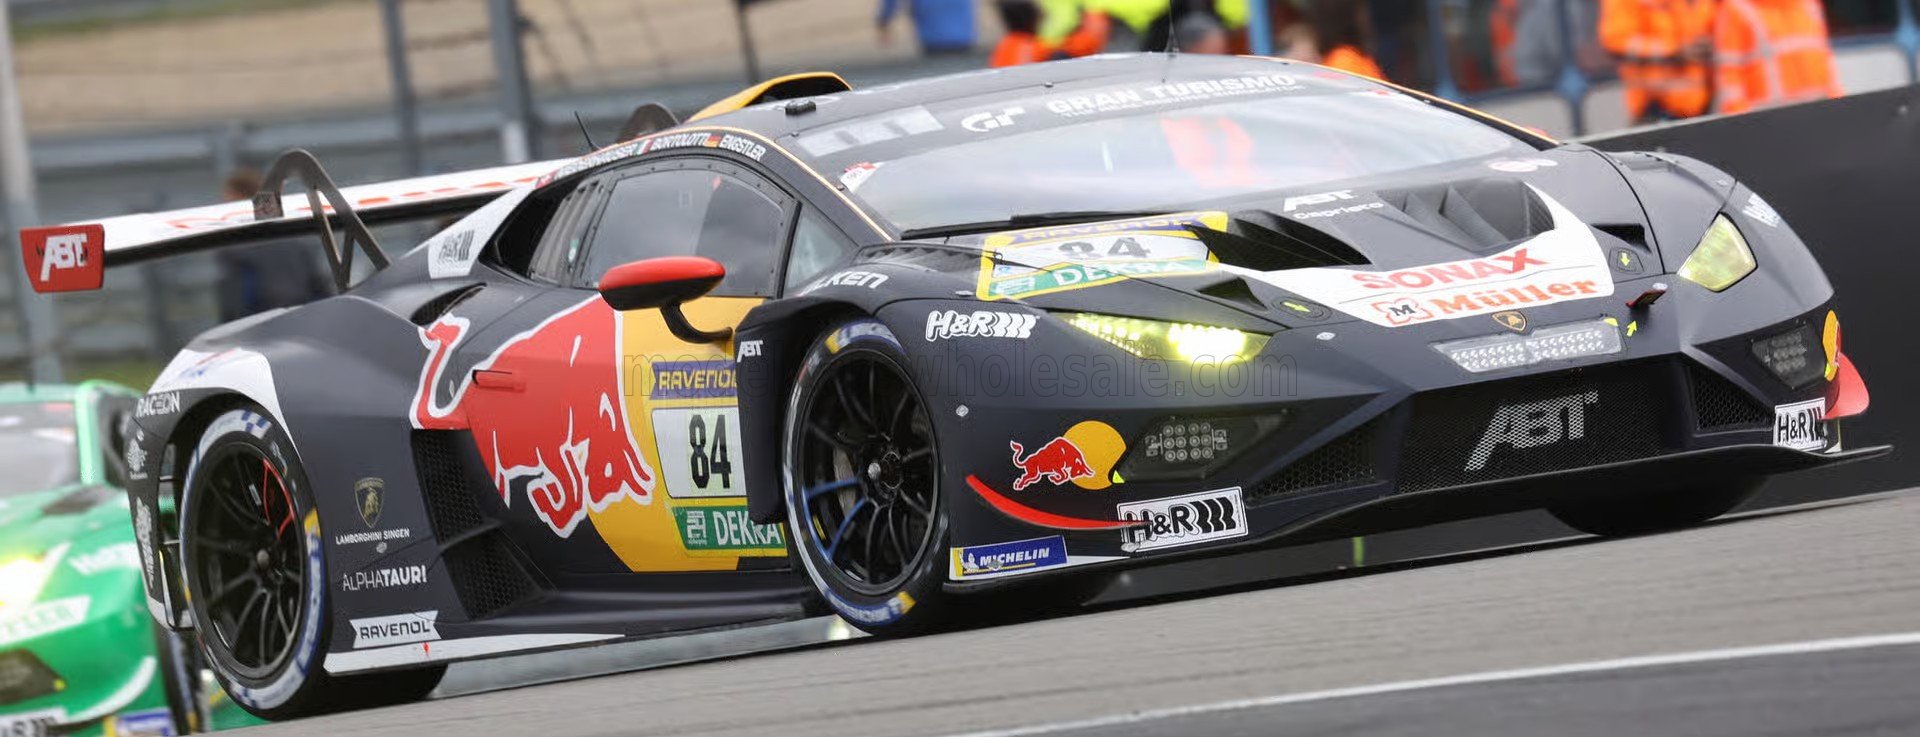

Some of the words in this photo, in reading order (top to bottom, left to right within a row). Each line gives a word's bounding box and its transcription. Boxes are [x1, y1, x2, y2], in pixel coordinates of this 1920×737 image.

[1048, 90, 1140, 113] GRAN
[1144, 75, 1296, 101] TURISMO
[720, 134, 767, 161] ENGSTLER
[40, 232, 88, 282] ABT
[1353, 248, 1549, 290] SONAX
[1430, 279, 1597, 314] Müller
[926, 310, 998, 342] H&R
[737, 340, 763, 363] ABT
[1464, 390, 1599, 472] ABT
[689, 415, 732, 489] 84
[335, 531, 383, 545] LAMBORGHINI
[383, 528, 410, 540] SINGEN
[712, 511, 781, 545] DEKRA
[360, 621, 431, 639] RAVENOL
